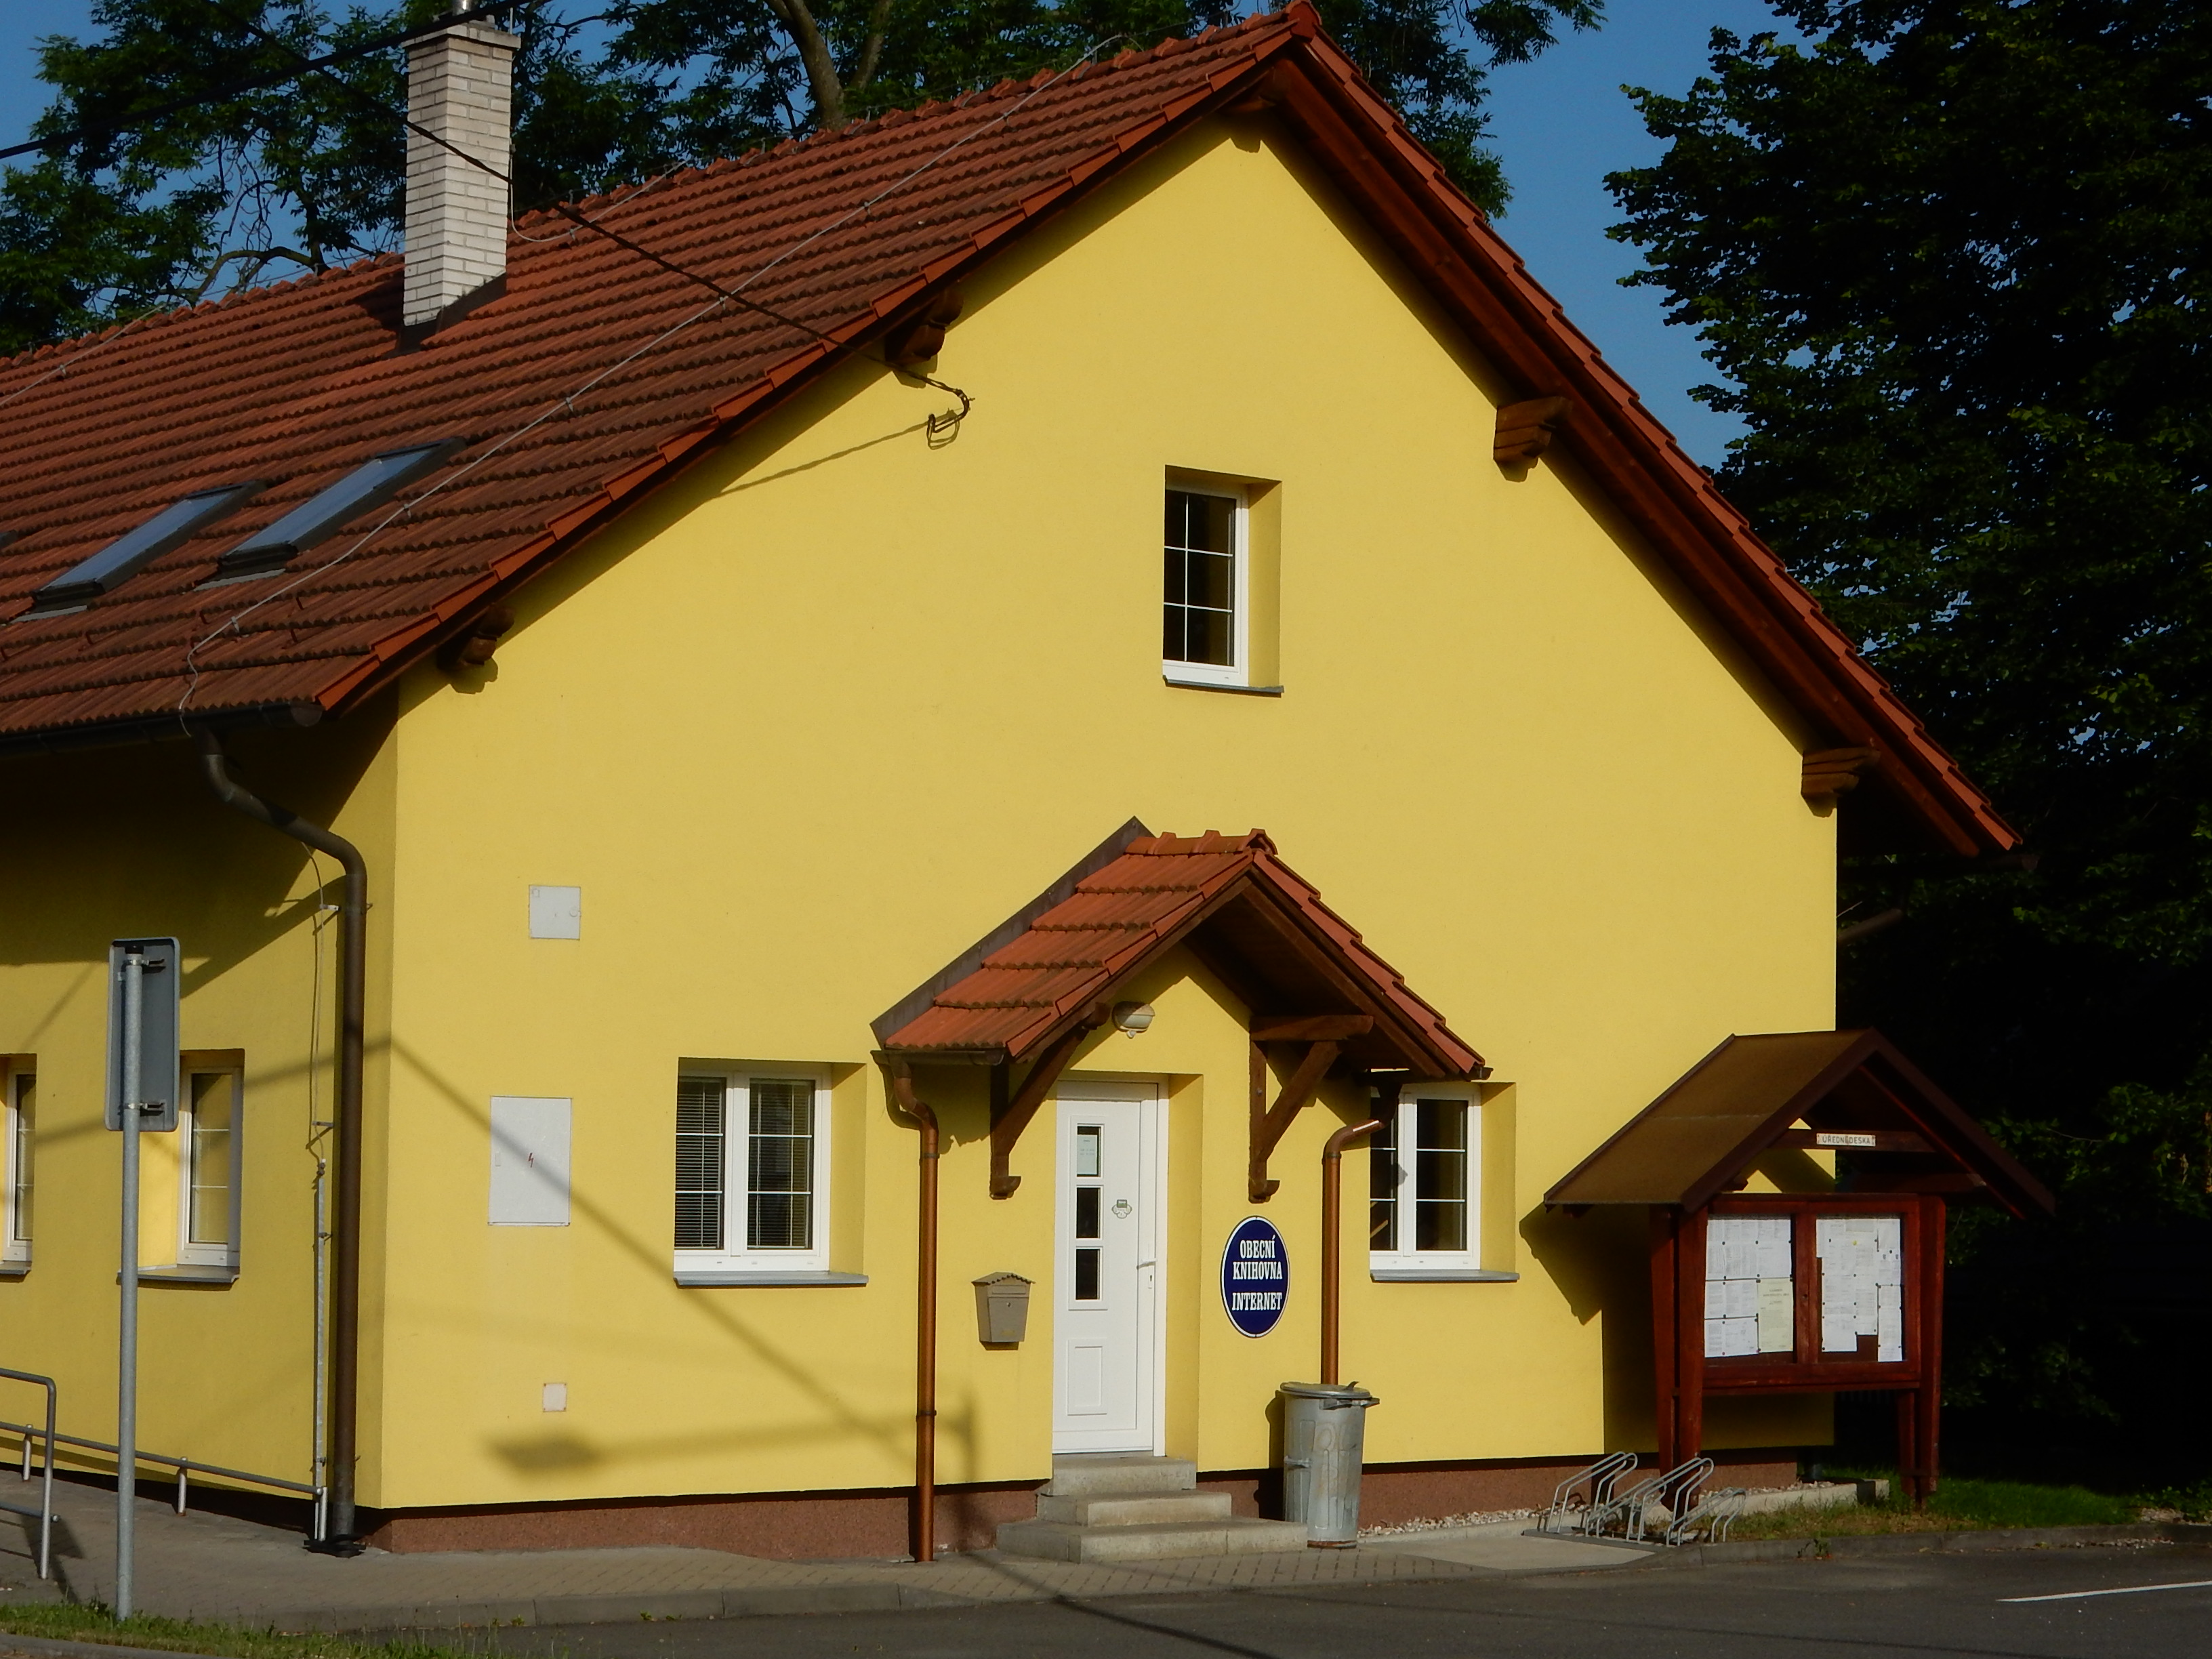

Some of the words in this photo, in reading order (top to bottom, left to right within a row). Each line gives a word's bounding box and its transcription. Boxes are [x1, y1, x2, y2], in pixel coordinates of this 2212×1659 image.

[1849, 1136, 1870, 1145] DESKA
[1240, 1235, 1275, 1258] OBECNÍ
[1233, 1261, 1282, 1279] KNIHOVNA
[1232, 1292, 1282, 1311] INTERNET
